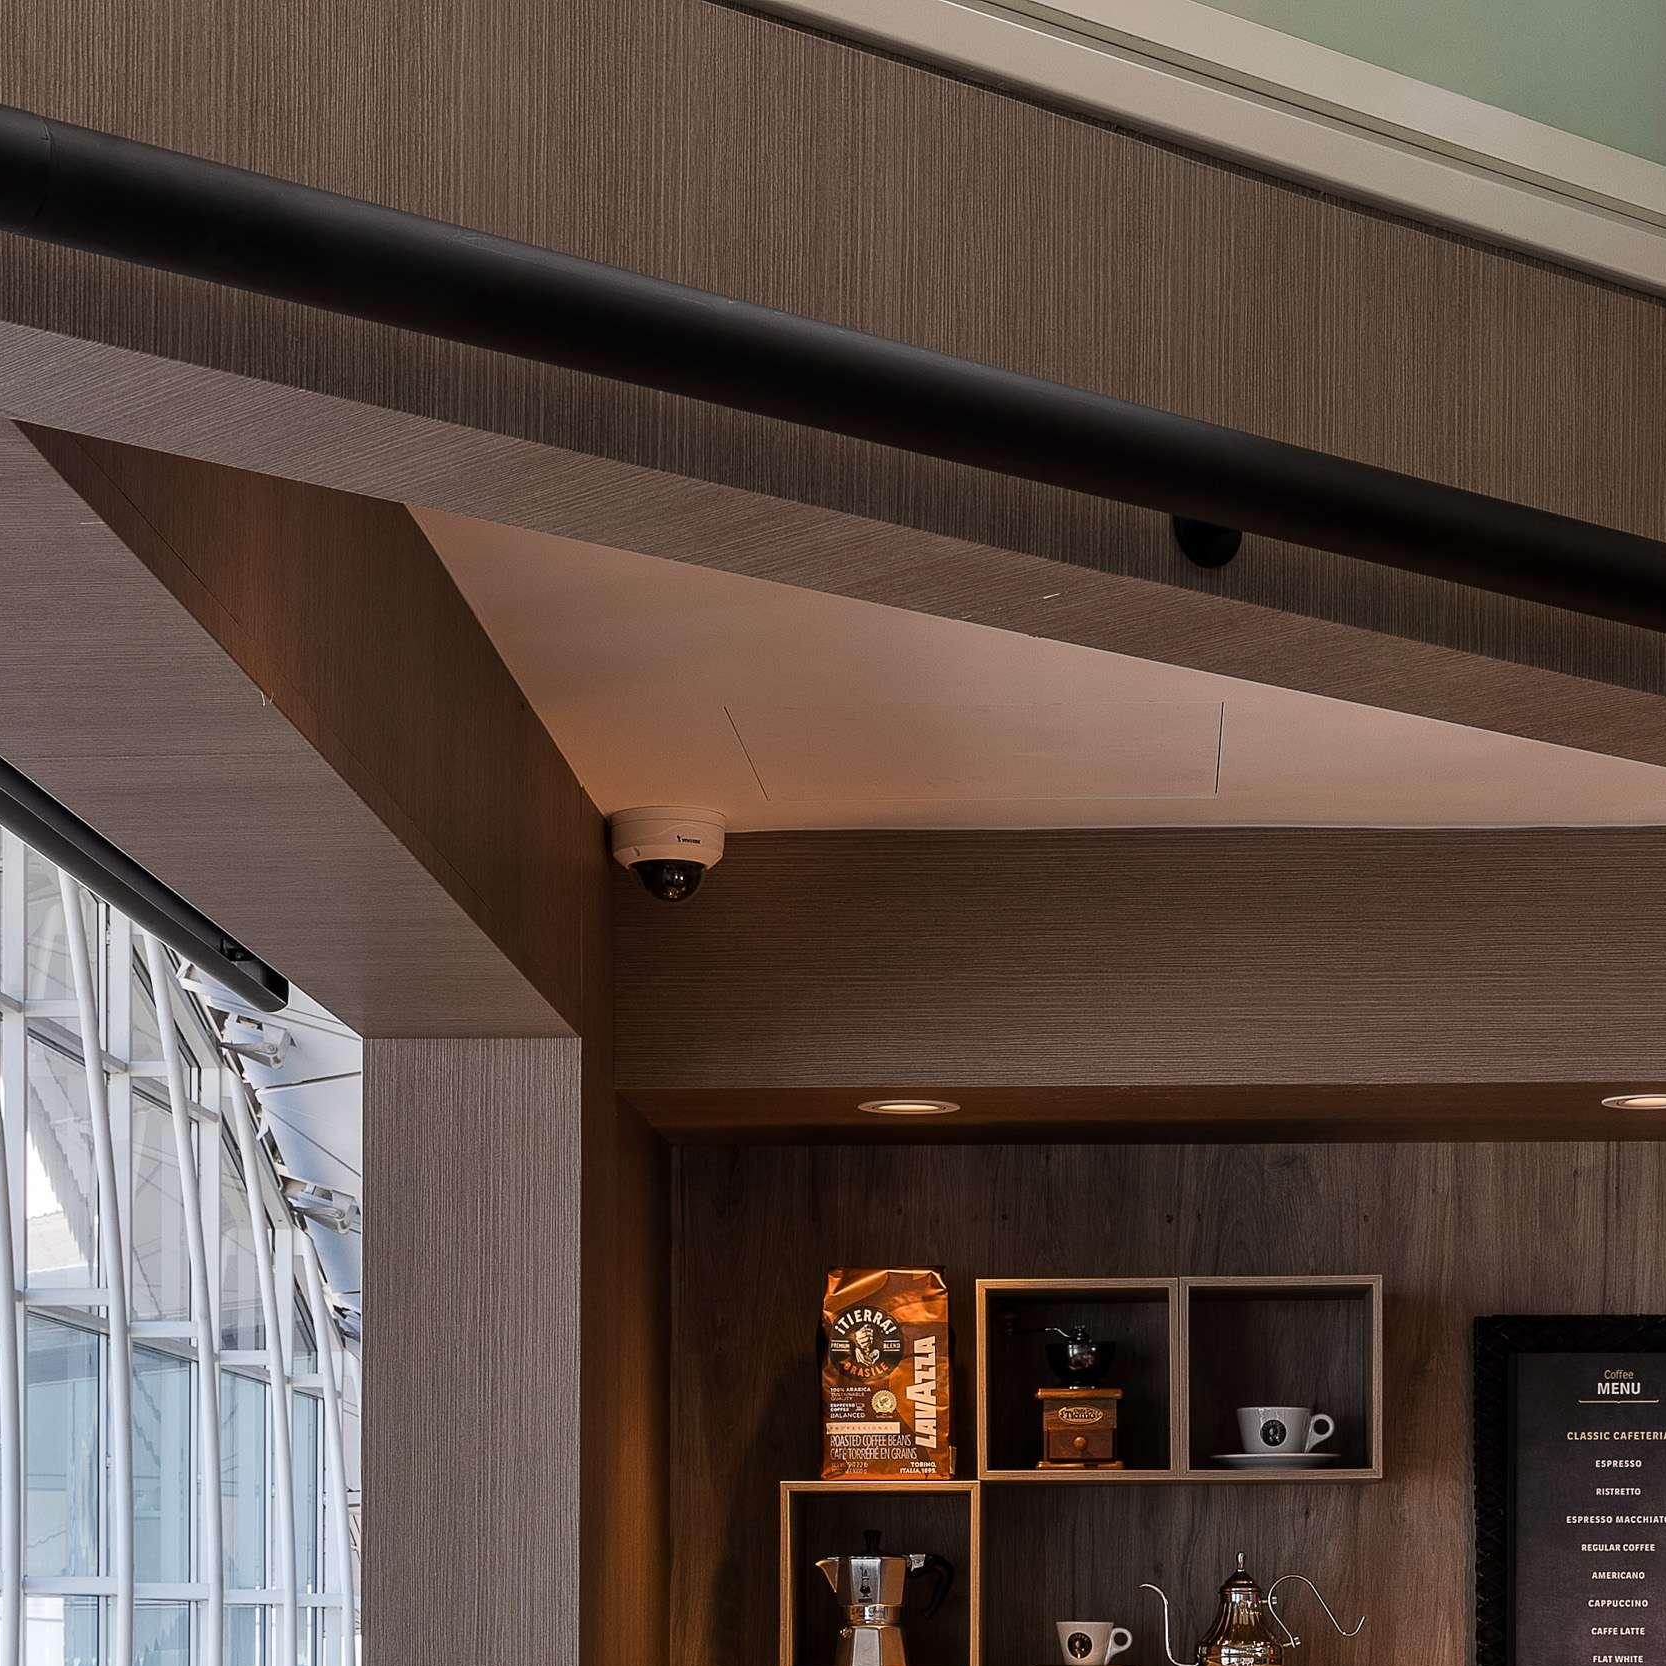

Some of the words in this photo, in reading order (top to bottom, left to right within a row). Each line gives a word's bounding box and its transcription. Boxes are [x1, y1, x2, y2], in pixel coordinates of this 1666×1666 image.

[843, 1362, 889, 1378] BRASILE
[1604, 1369, 1634, 1379] Coffee
[906, 1335, 937, 1449] LAVAZZA
[1597, 1382, 1641, 1395] MENU
[1567, 1431, 1611, 1440] CLASSIC
[830, 1435, 861, 1447] ROASTED
[888, 1435, 912, 1447] BEANS
[1595, 1460, 1642, 1468] ESPRESSO
[1595, 1488, 1641, 1496] RISTRETTO
[1566, 1516, 1613, 1524] ESPRESSO
[1581, 1544, 1621, 1552] REGULAR
[1623, 1544, 1655, 1552] COFFEE
[1591, 1571, 1645, 1580] AMERICANO
[1588, 1599, 1649, 1608] CAPPUCCINO
[1620, 1627, 1645, 1636] LATTE
[1593, 1655, 1613, 1663] FLAT
[1615, 1655, 1643, 1663] WHITE
